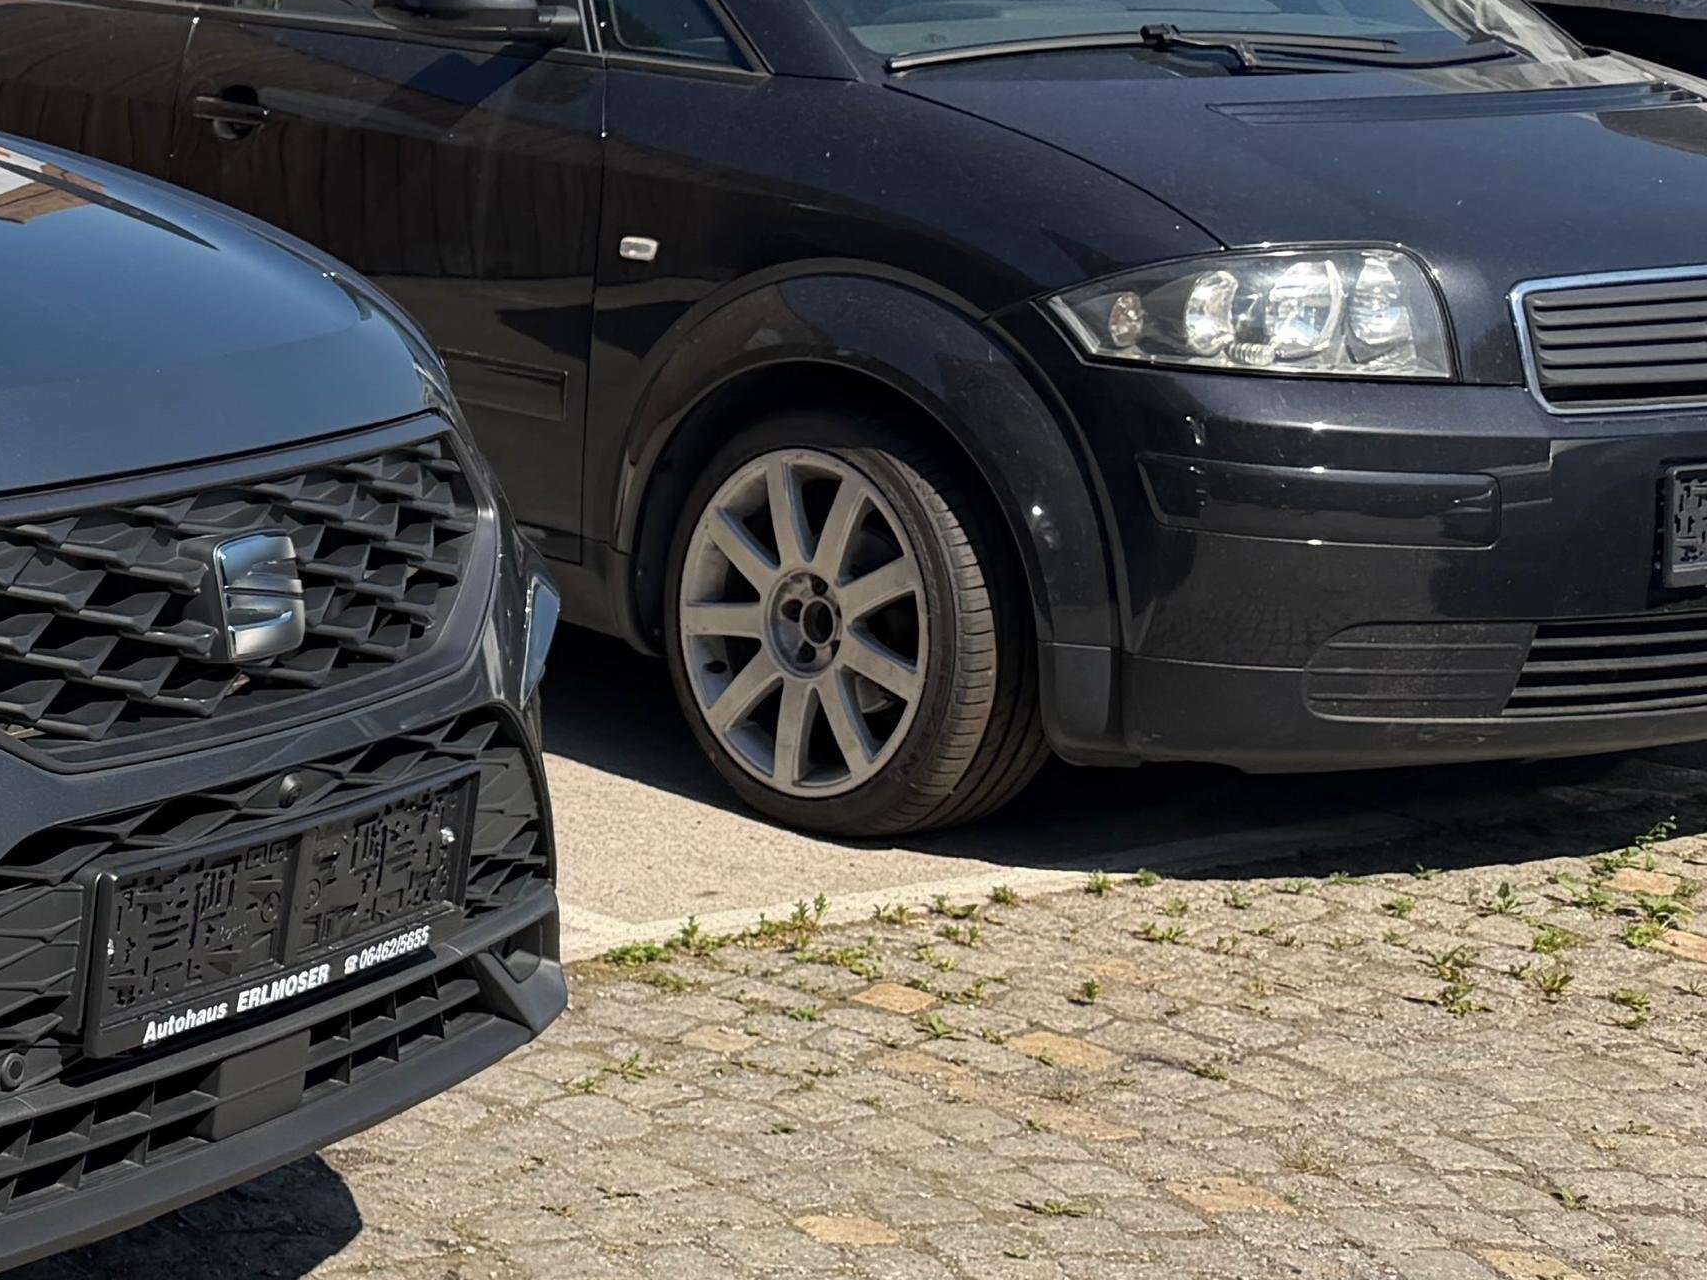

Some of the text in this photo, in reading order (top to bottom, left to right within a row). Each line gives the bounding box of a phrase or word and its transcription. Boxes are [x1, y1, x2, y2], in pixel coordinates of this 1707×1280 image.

[143, 925, 432, 1045] Autohaus ERLMOSER 06462/5655
